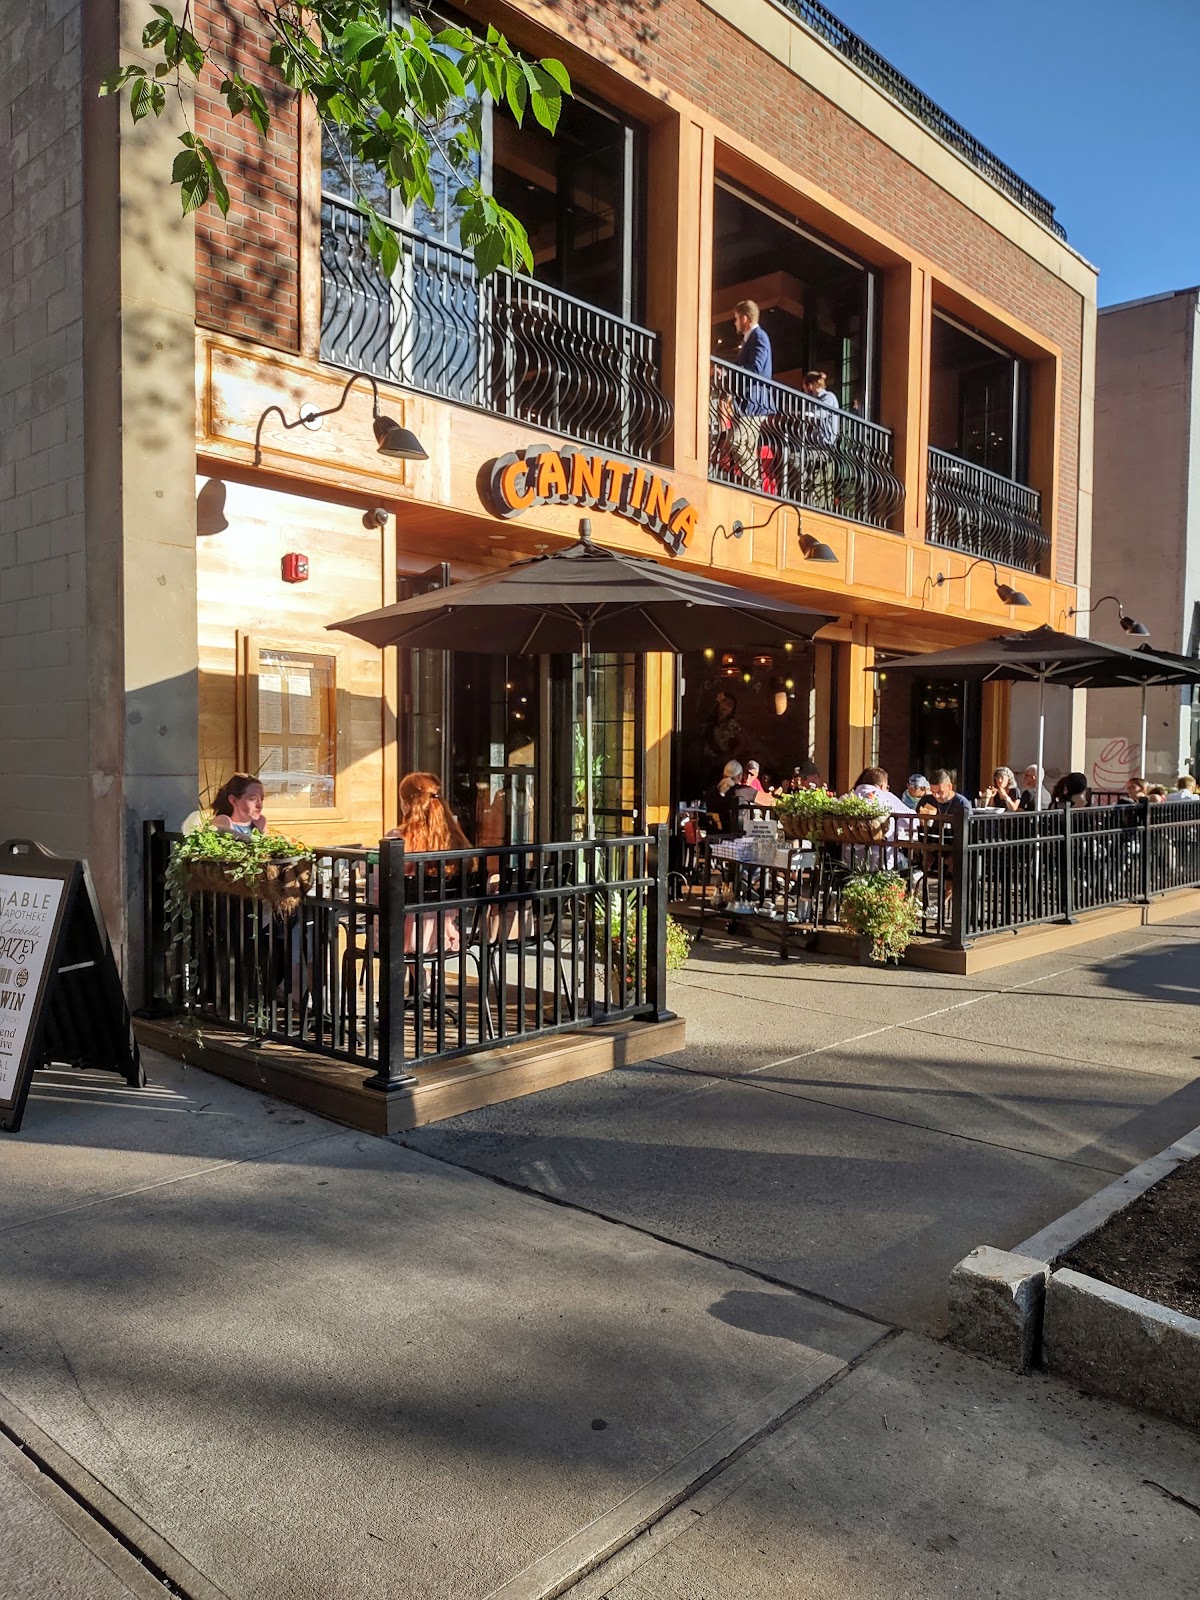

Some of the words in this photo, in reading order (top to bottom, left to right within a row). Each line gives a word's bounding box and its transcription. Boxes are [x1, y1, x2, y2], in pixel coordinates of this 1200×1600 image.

[501, 451, 699, 548] CANTINA
[6, 891, 52, 909] ABLE
[3, 909, 47, 922] APOTHEKE
